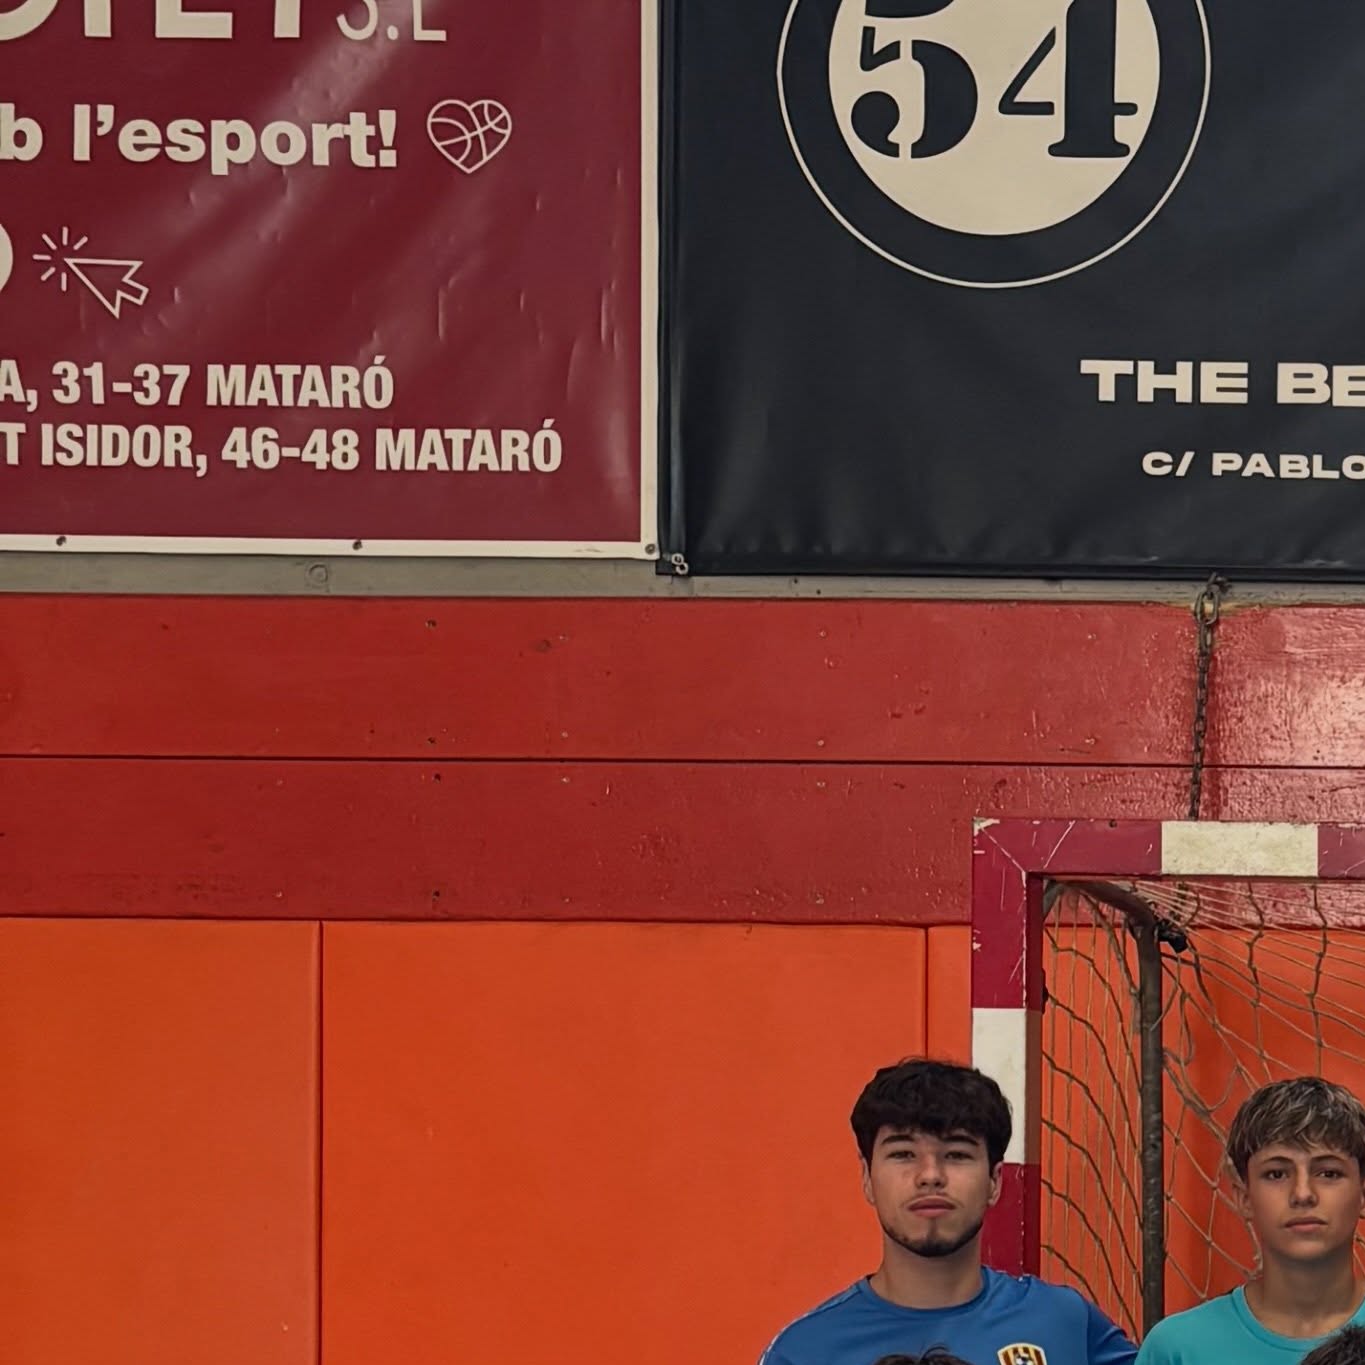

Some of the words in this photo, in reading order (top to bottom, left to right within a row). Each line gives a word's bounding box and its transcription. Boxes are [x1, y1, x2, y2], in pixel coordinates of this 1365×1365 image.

[851, 0, 1137, 158] 54
[74, 104, 396, 175] l'esport!
[53, 361, 190, 405] 31-37
[207, 356, 393, 408] MATARÓ
[1081, 360, 1248, 403] THE
[42, 424, 207, 477] ISIDOR,
[222, 427, 359, 470] 46-48
[376, 419, 561, 472] MATARÓ
[1143, 452, 1194, 476] C/
